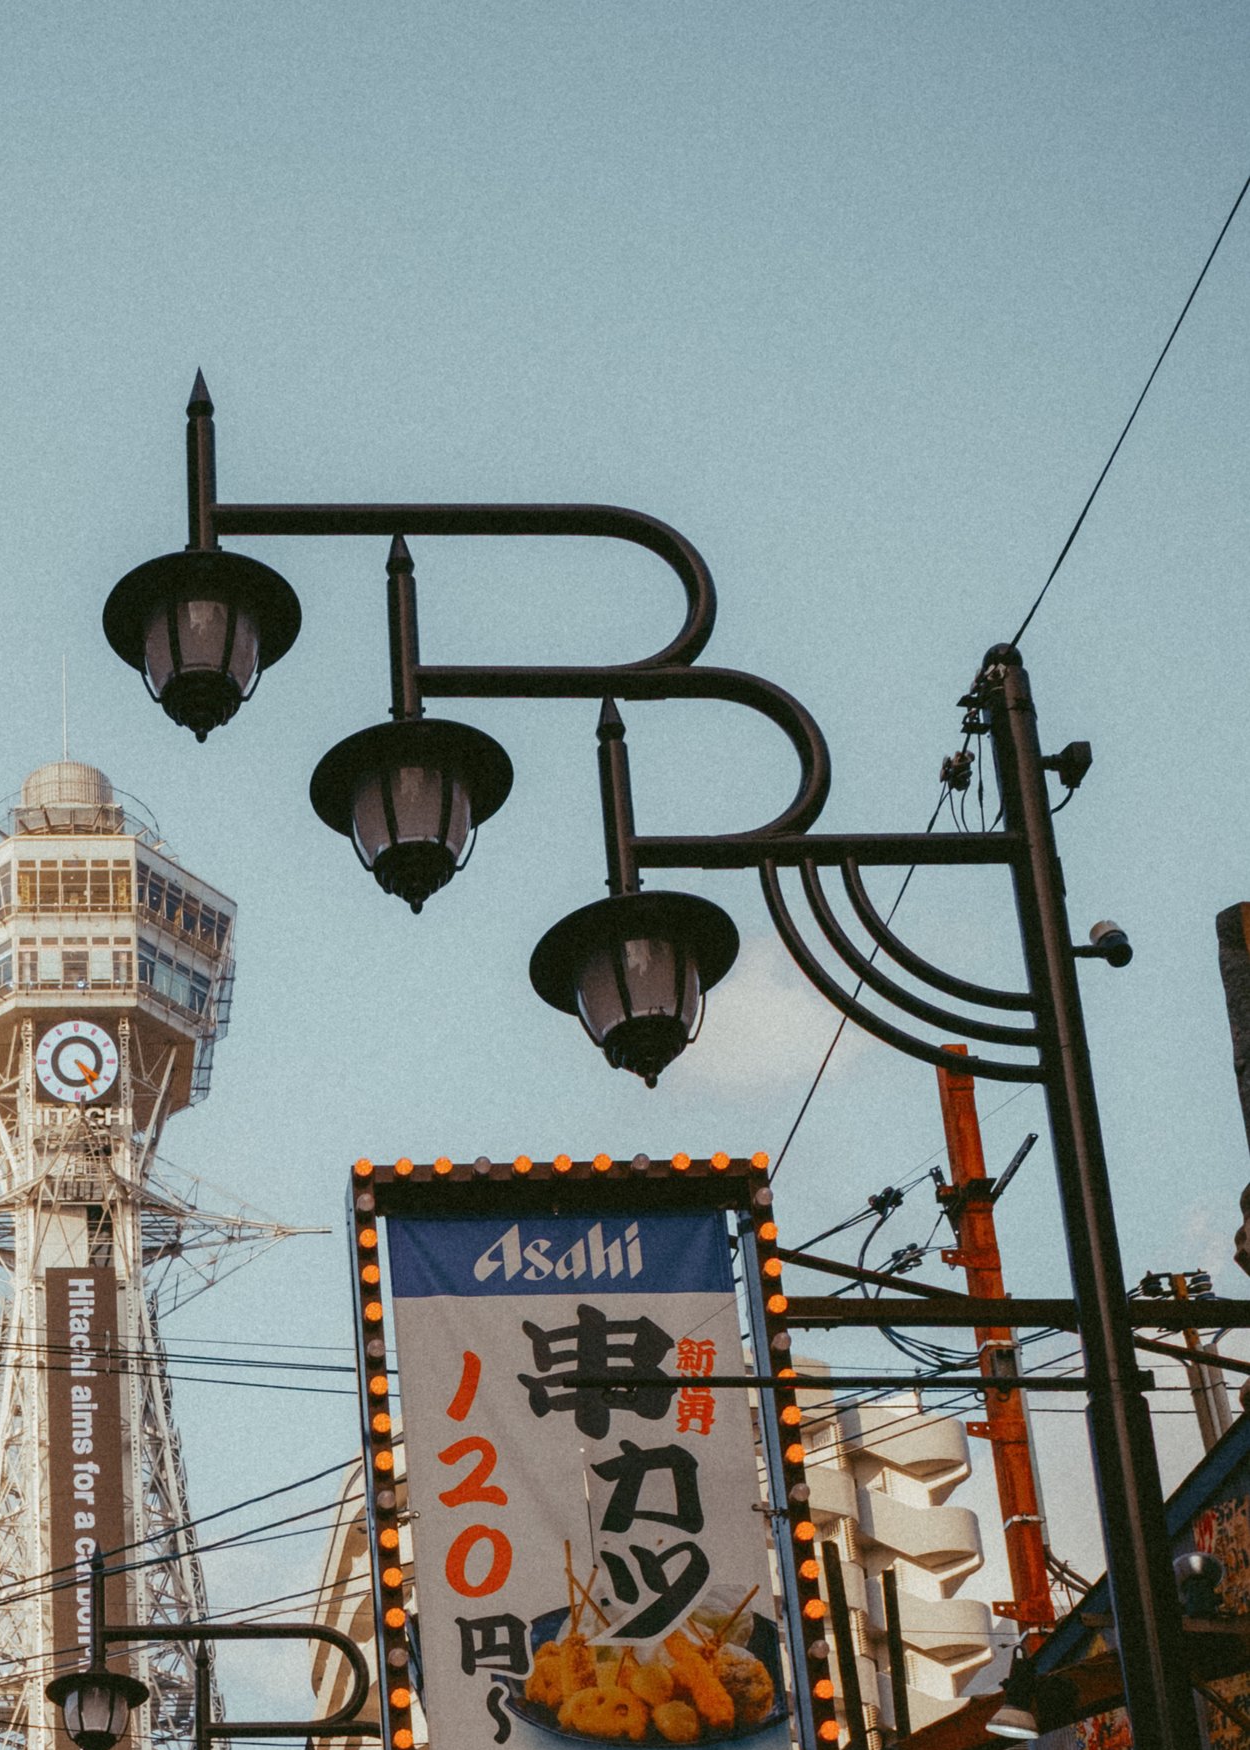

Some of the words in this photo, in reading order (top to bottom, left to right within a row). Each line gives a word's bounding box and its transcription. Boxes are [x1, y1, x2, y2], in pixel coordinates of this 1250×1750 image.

[24, 1107, 133, 1127] HITACHI
[473, 1222, 643, 1283] Asahi
[68, 1278, 98, 1377] Hitachi
[70, 1385, 99, 1455] aims
[72, 1461, 101, 1505] for
[518, 1302, 711, 1641] 串カツ
[73, 1511, 97, 1530] a
